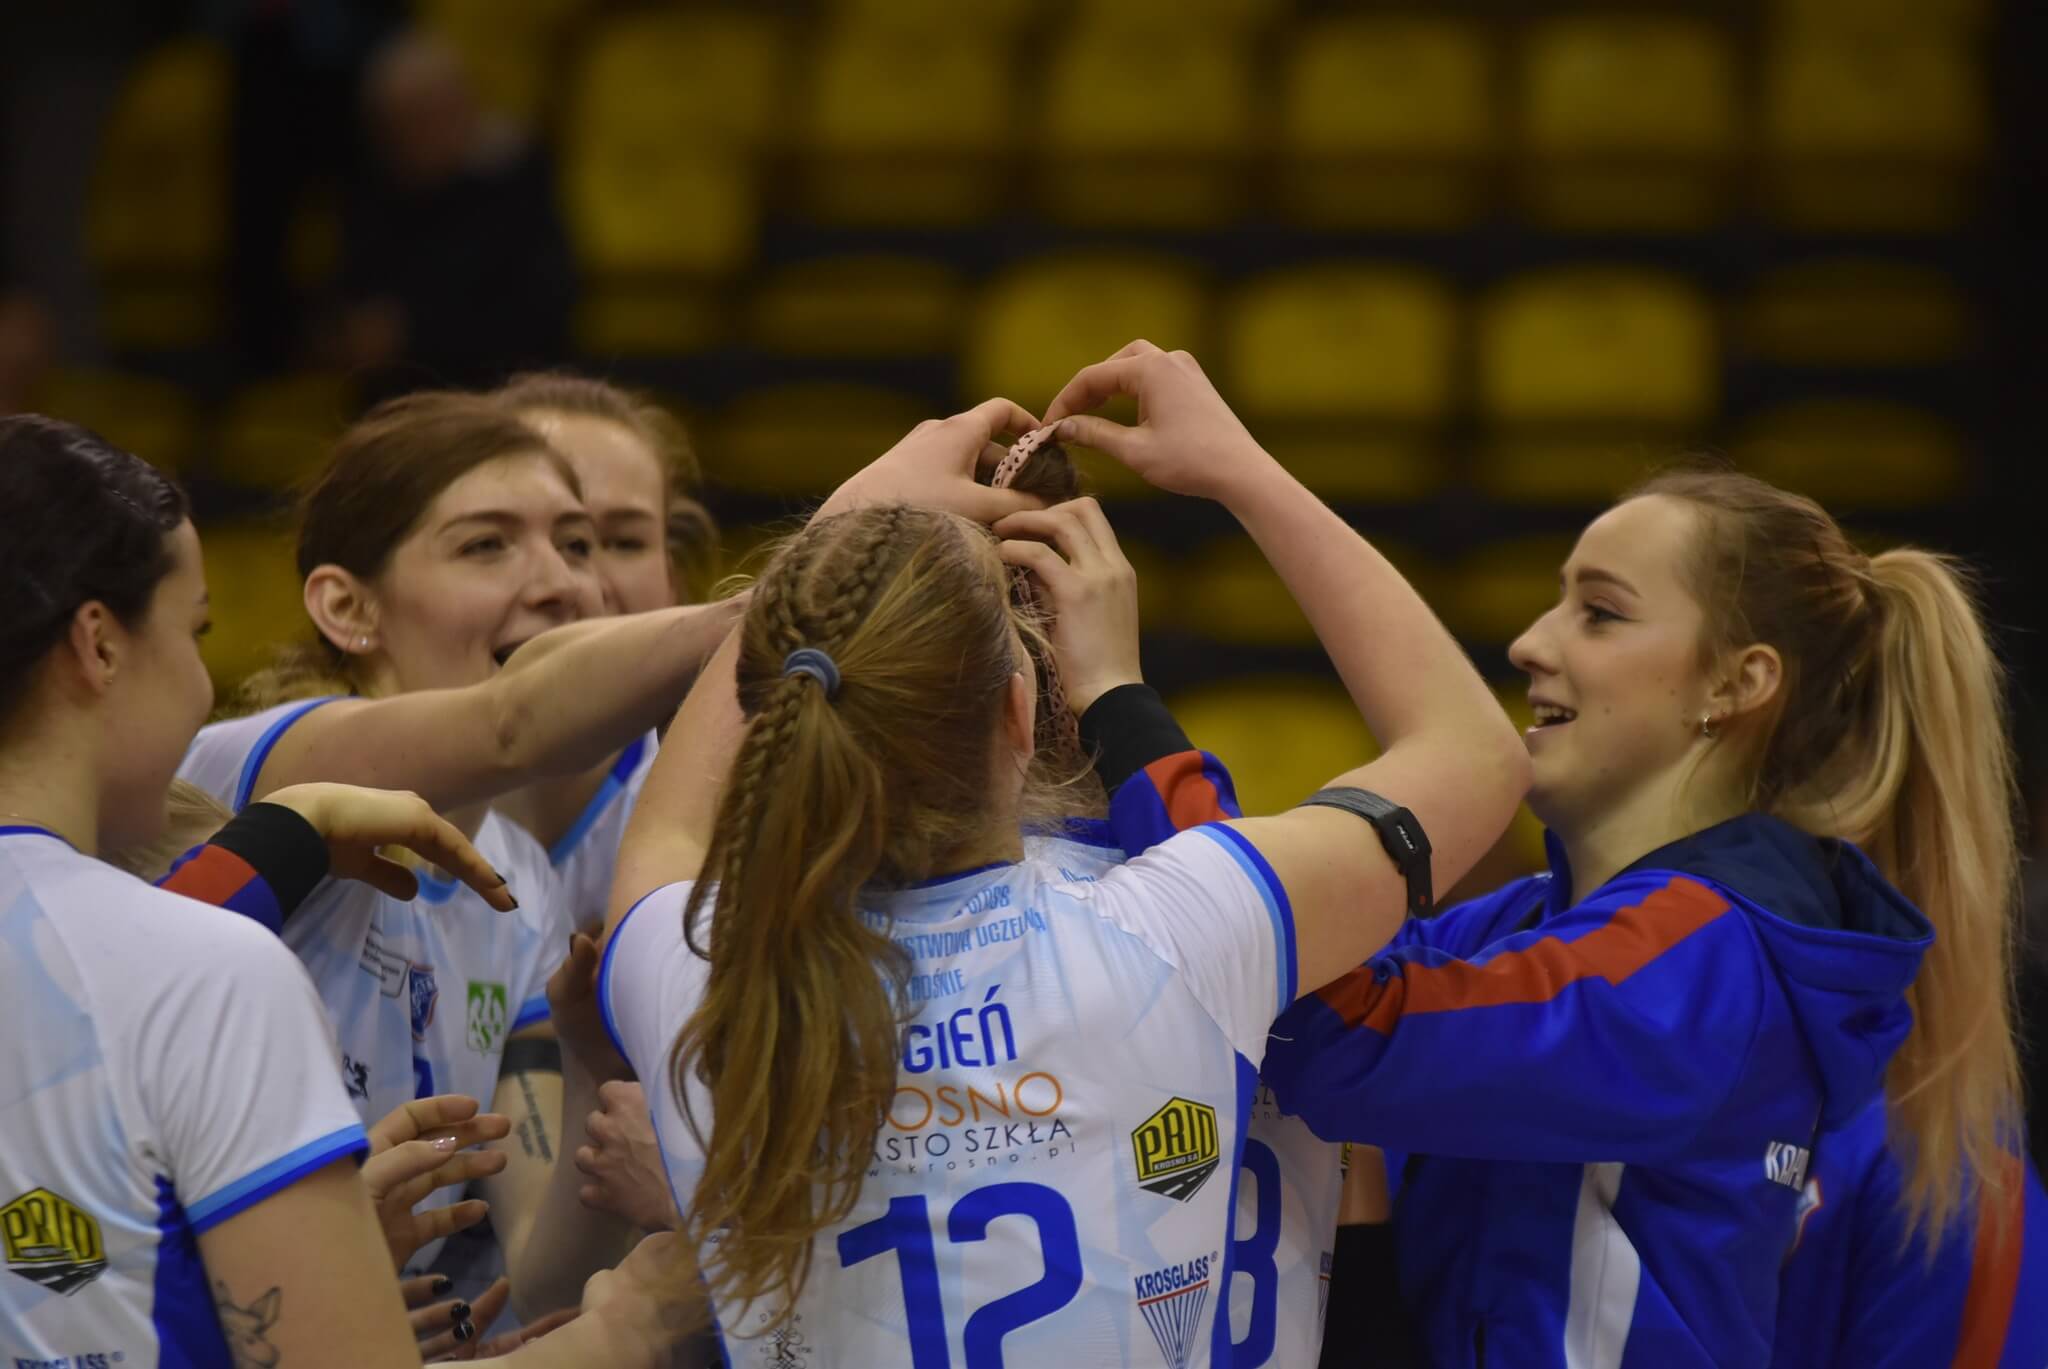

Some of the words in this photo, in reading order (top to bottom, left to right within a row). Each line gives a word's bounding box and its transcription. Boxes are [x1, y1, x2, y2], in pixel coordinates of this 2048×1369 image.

[894, 927, 973, 961] STWOWA
[903, 984, 1018, 1074] GIEŃ
[885, 1071, 1064, 1132] OSNO
[867, 1141, 1076, 1178] w.krosno.pl
[964, 1117, 1073, 1153] SZKŁA
[1136, 1104, 1215, 1176] PRID
[3, 1197, 95, 1258] PRID
[837, 1181, 1084, 1369] 12
[1134, 1256, 1210, 1299] KROSGLASS
